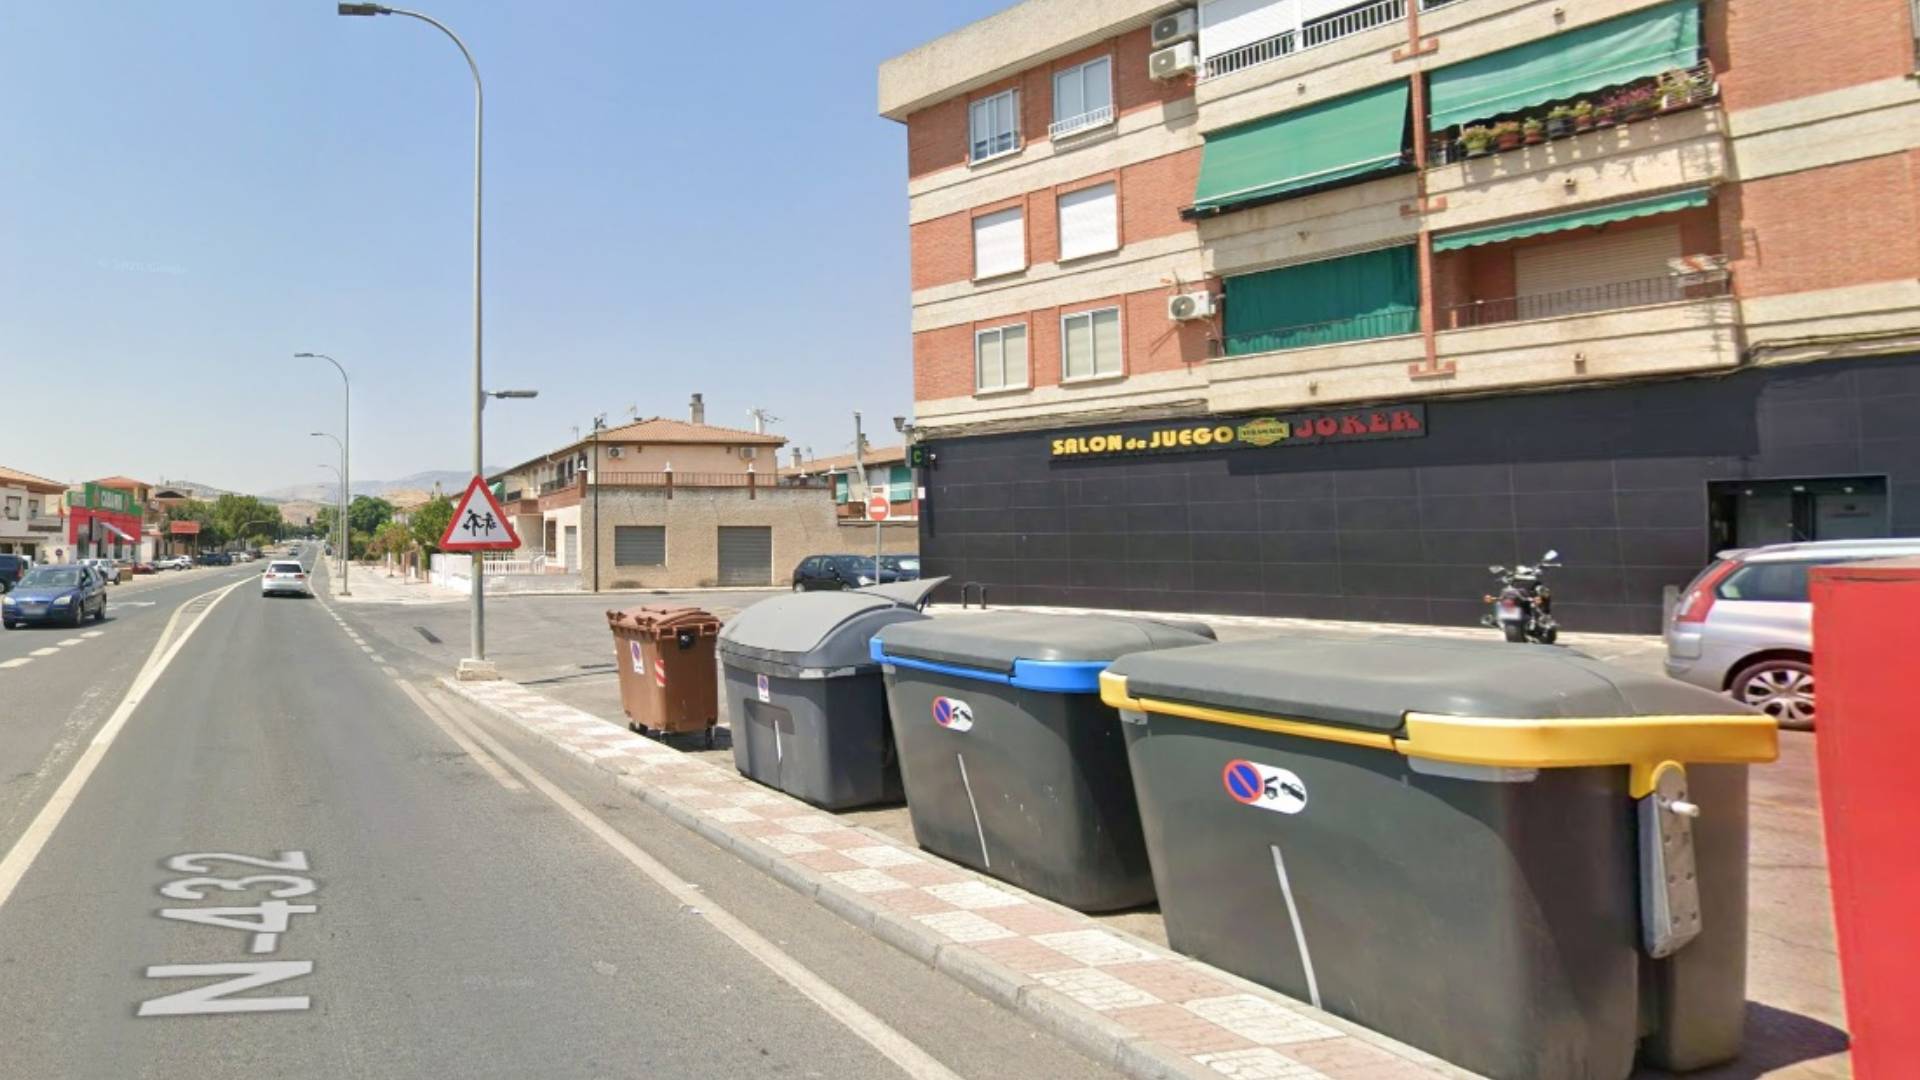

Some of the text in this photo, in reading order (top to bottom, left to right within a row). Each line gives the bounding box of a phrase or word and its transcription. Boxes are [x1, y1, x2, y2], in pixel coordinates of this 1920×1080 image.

[1295, 411, 1420, 438] JOKER
[1052, 426, 1234, 455] SALON de JUEGO
